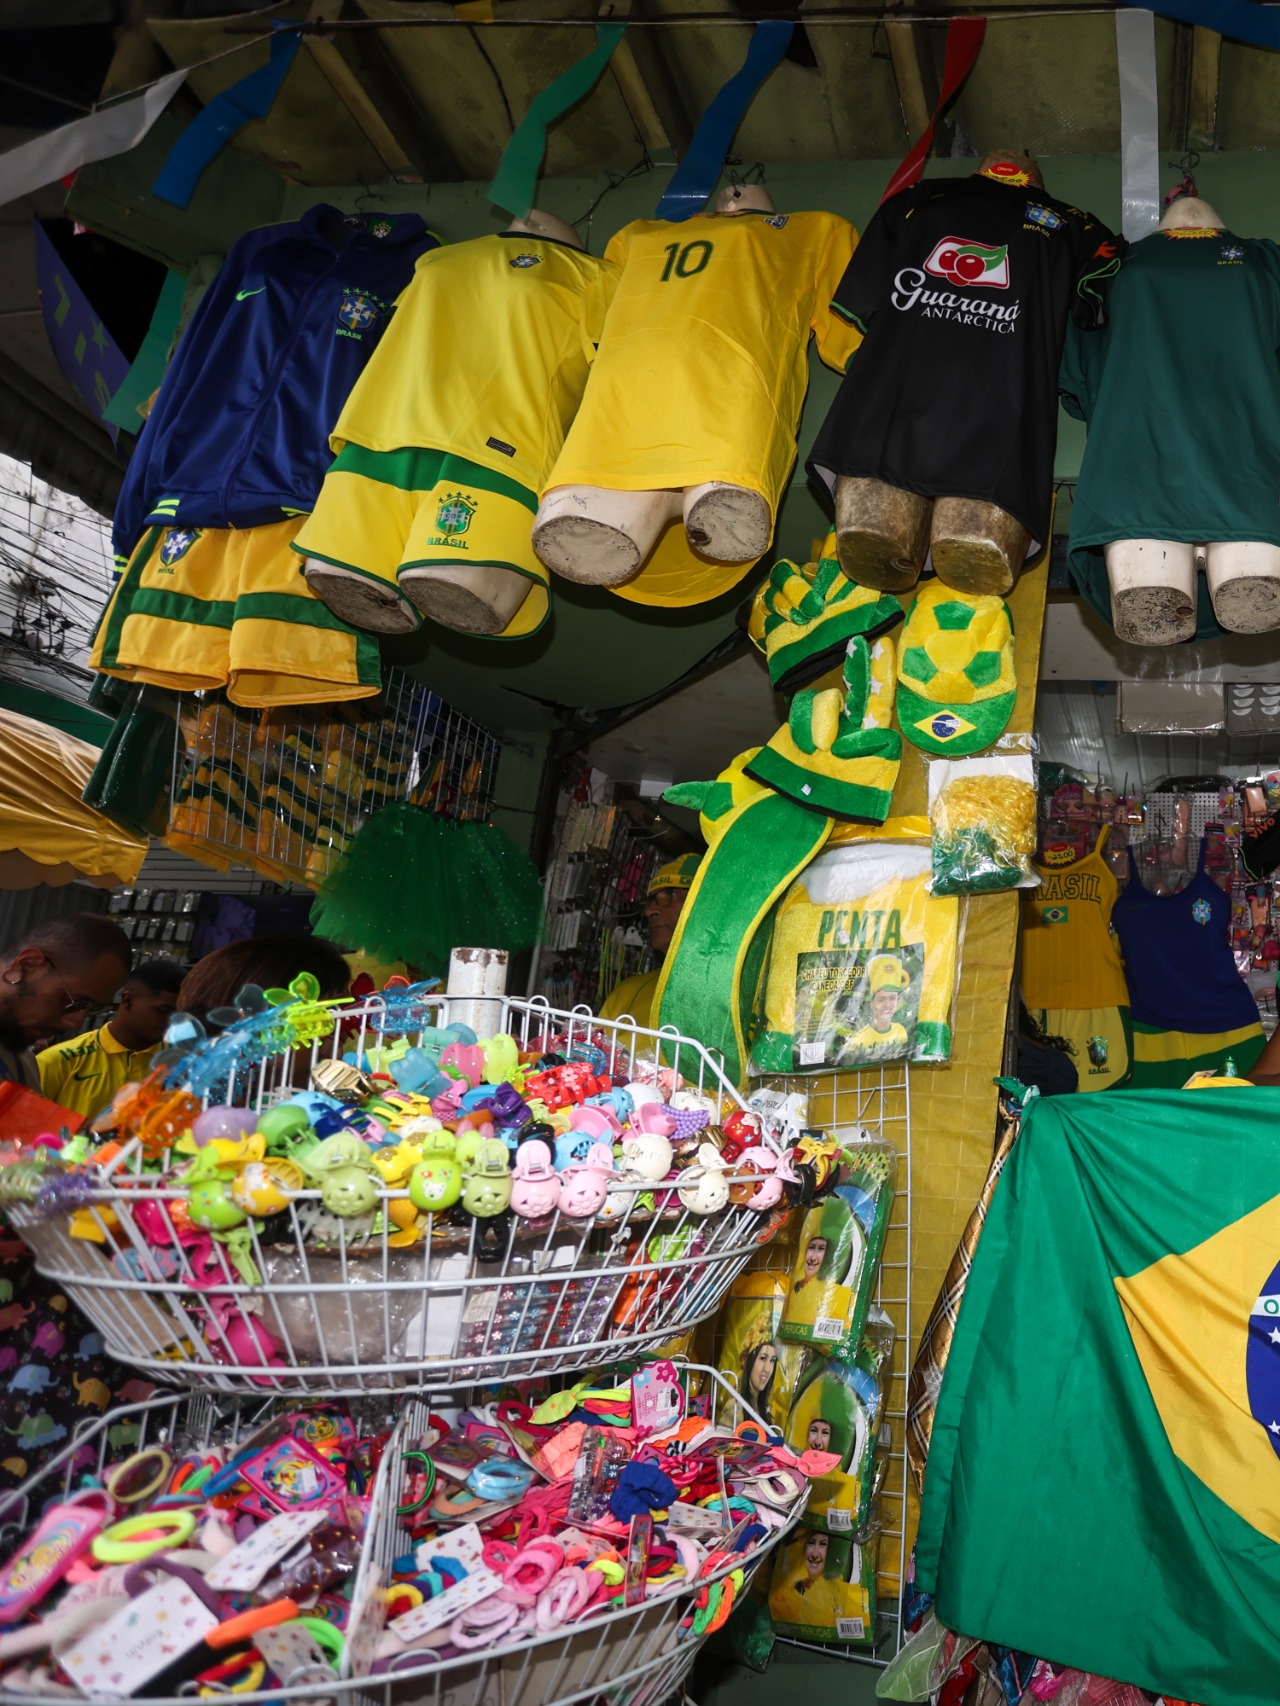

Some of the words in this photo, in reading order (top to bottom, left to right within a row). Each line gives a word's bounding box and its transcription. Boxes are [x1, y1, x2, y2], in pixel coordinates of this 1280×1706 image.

[1023, 223, 1051, 238] BRASIL
[660, 240, 714, 282] 10
[891, 267, 1021, 321] Guaraná
[921, 306, 1015, 334] ANTARCTICA
[335, 328, 363, 340] BRASIL
[427, 537, 469, 550] BRASIL
[817, 908, 901, 950] PENTA
[800, 1626, 832, 1638] PERUCAS
